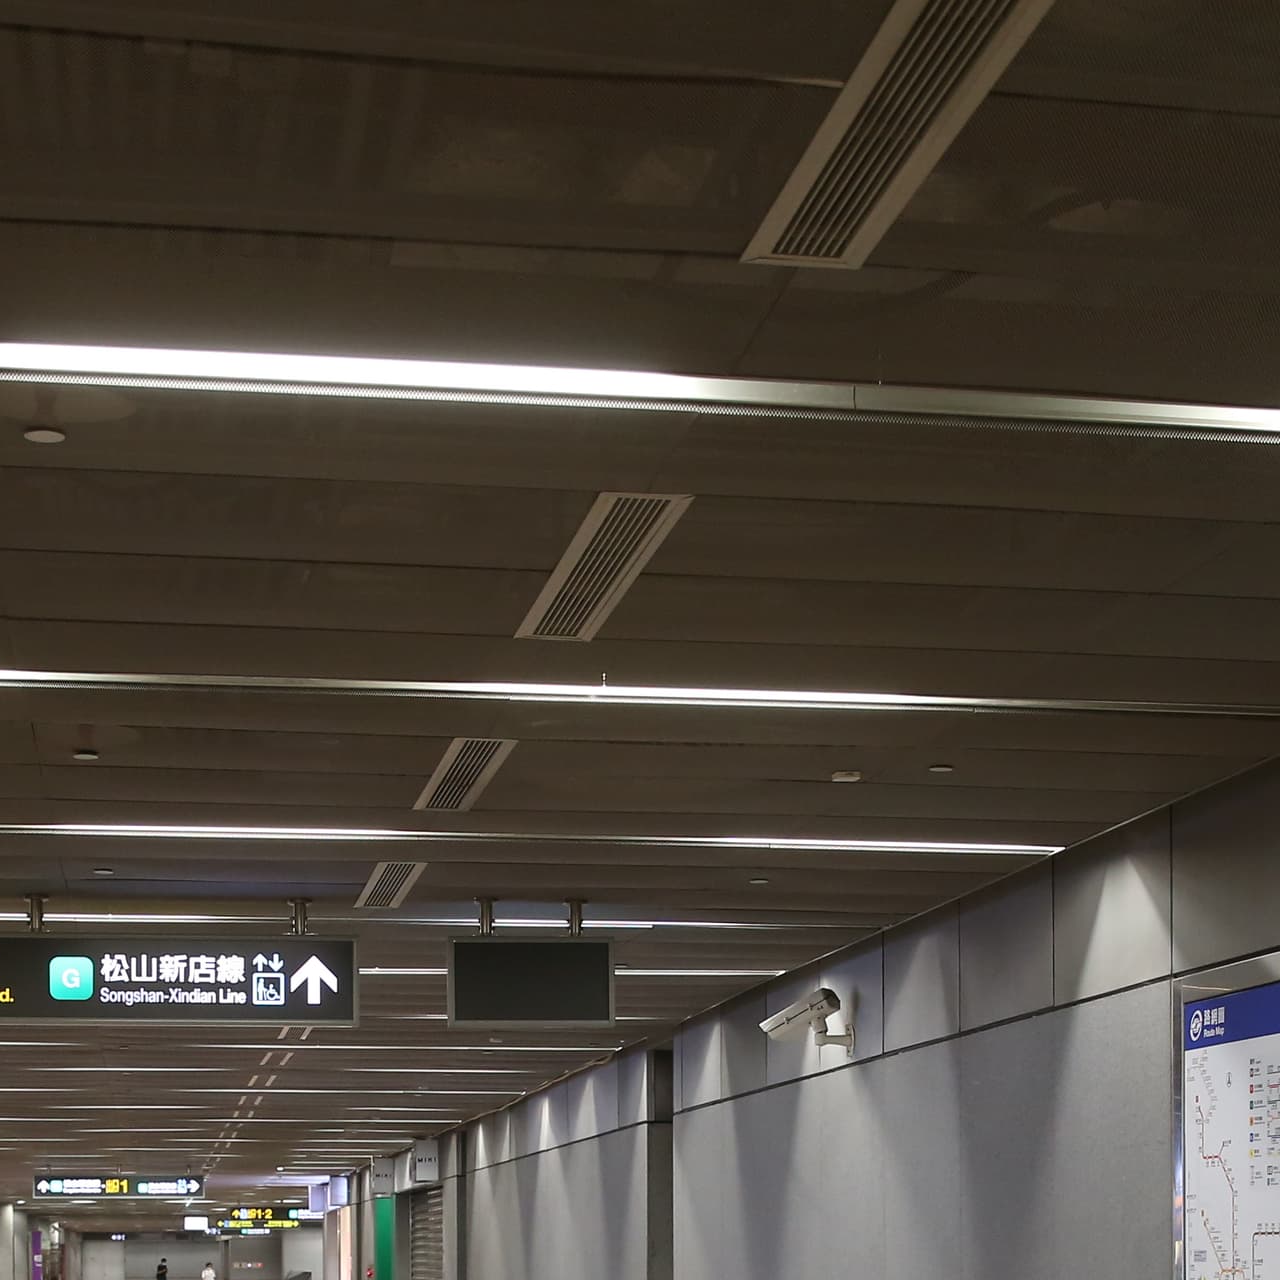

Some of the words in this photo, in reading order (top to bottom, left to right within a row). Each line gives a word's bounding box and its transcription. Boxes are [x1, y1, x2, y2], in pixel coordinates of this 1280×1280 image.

[99, 952, 247, 984] 松山新店線
[61, 969, 81, 990] G
[99, 986, 216, 1007] Songshan-Xindian
[219, 986, 247, 1004] Line
[1203, 1029, 1215, 1038] Route
